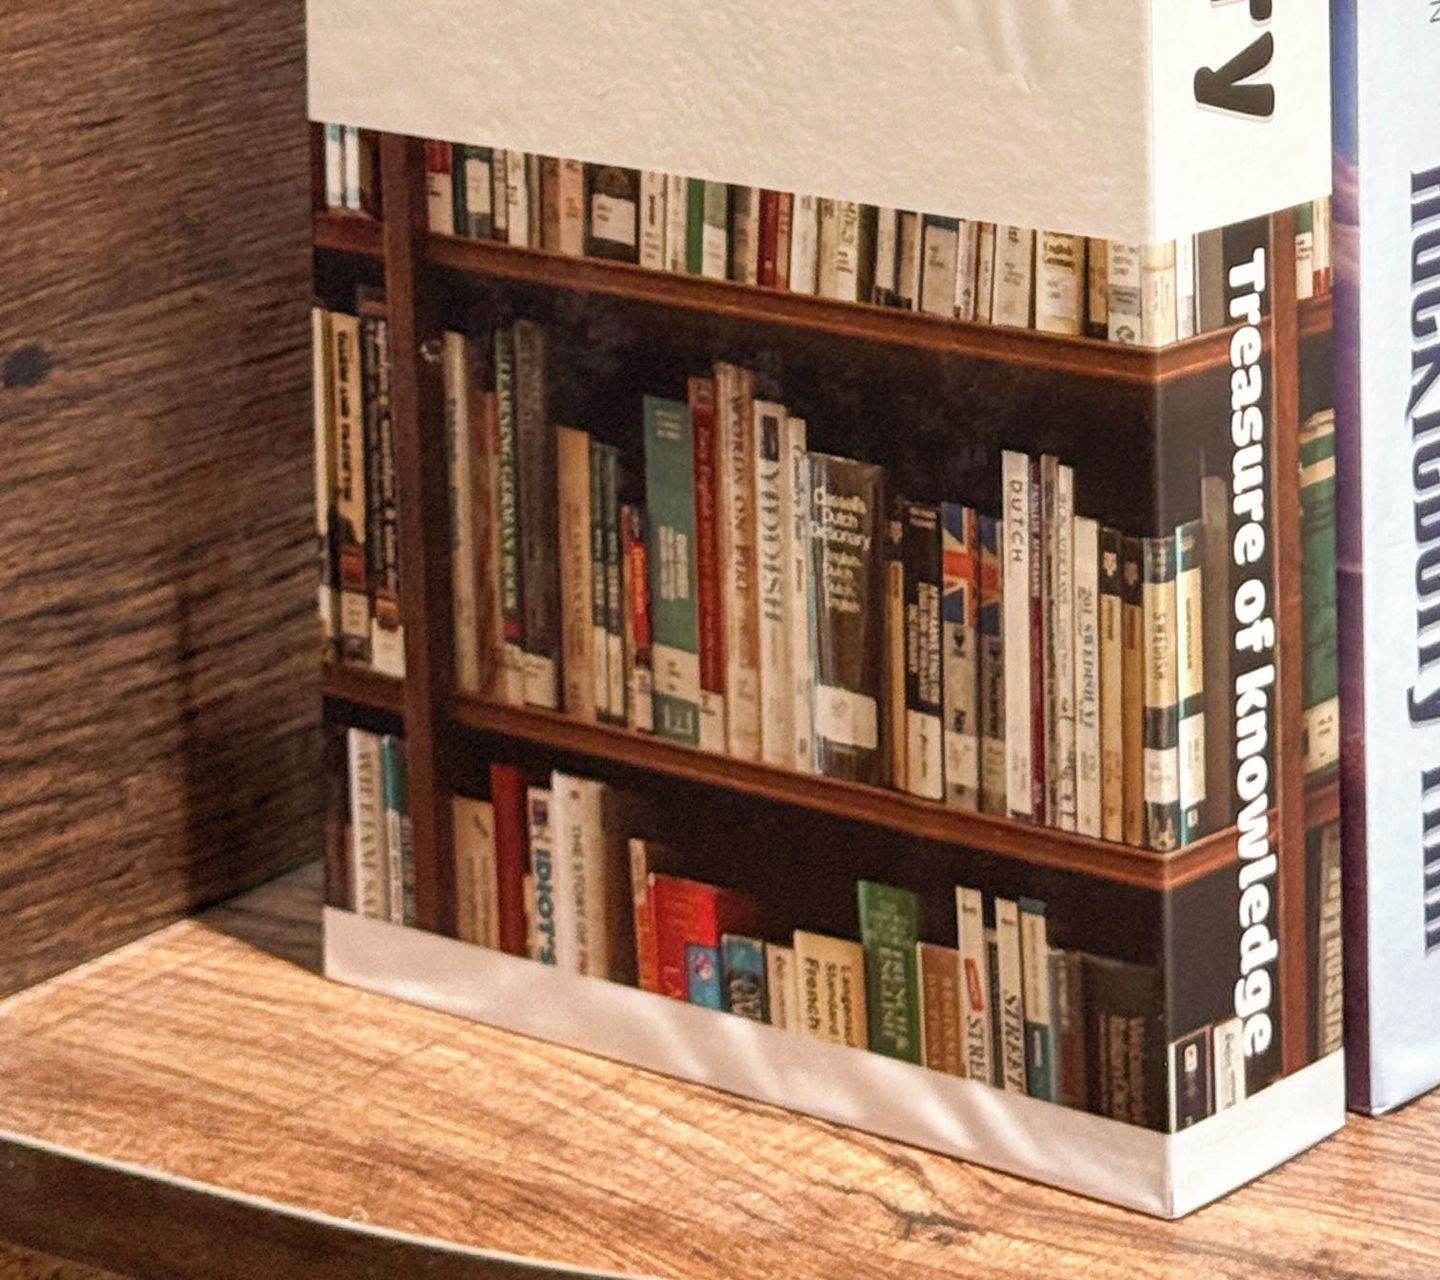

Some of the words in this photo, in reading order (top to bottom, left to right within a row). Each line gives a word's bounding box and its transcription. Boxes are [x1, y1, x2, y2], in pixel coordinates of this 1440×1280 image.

[1229, 247, 1268, 565] Treasure
[760, 467, 783, 624] YIDDISH
[1009, 480, 1023, 563] DUTCH
[1152, 611, 1169, 682] SWEDISH
[1235, 580, 1274, 653] of
[1235, 664, 1279, 1058] knowledge
[535, 849, 558, 968] IDIOT'S
[804, 957, 821, 1031] French
[825, 961, 840, 1037] Standard
[1003, 993, 1025, 1091] STREET
